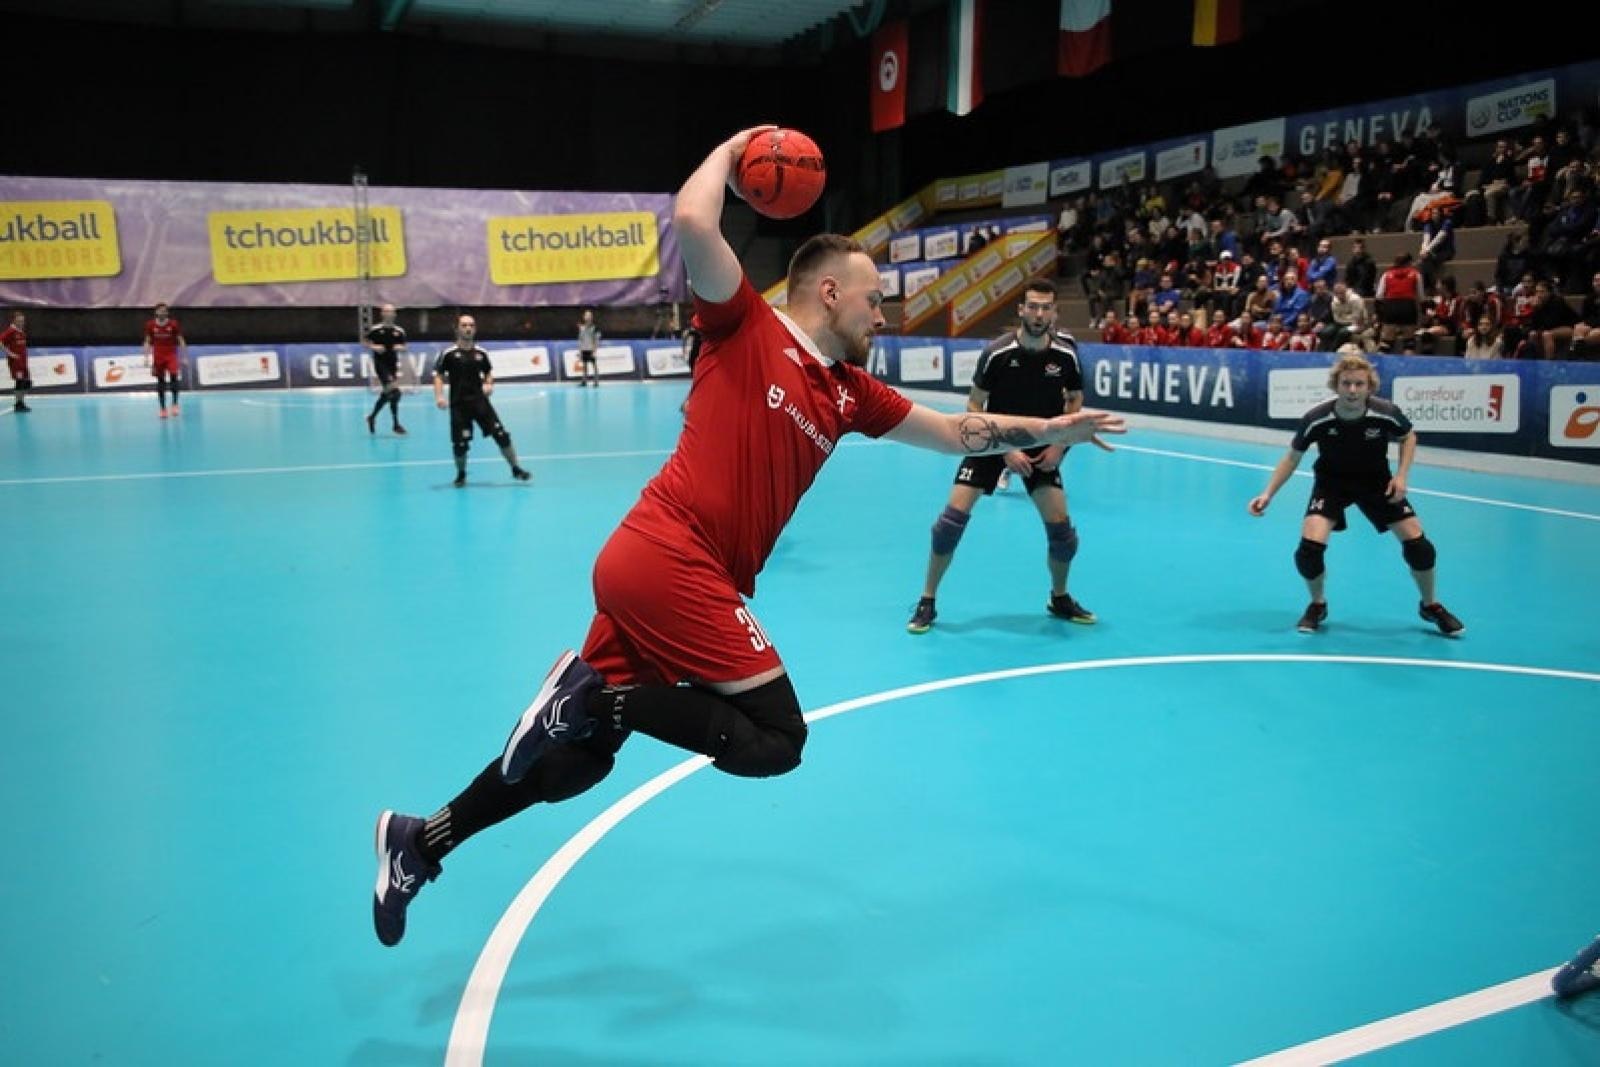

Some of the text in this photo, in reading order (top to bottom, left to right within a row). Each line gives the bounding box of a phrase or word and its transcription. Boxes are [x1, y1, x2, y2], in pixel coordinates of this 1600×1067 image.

[224, 217, 390, 249] tchoukball
[500, 222, 644, 252] tchoukball
[1094, 359, 1234, 408] GENEVA
[1405, 386, 1464, 401] Carrefour
[1406, 402, 1484, 421] addiction
